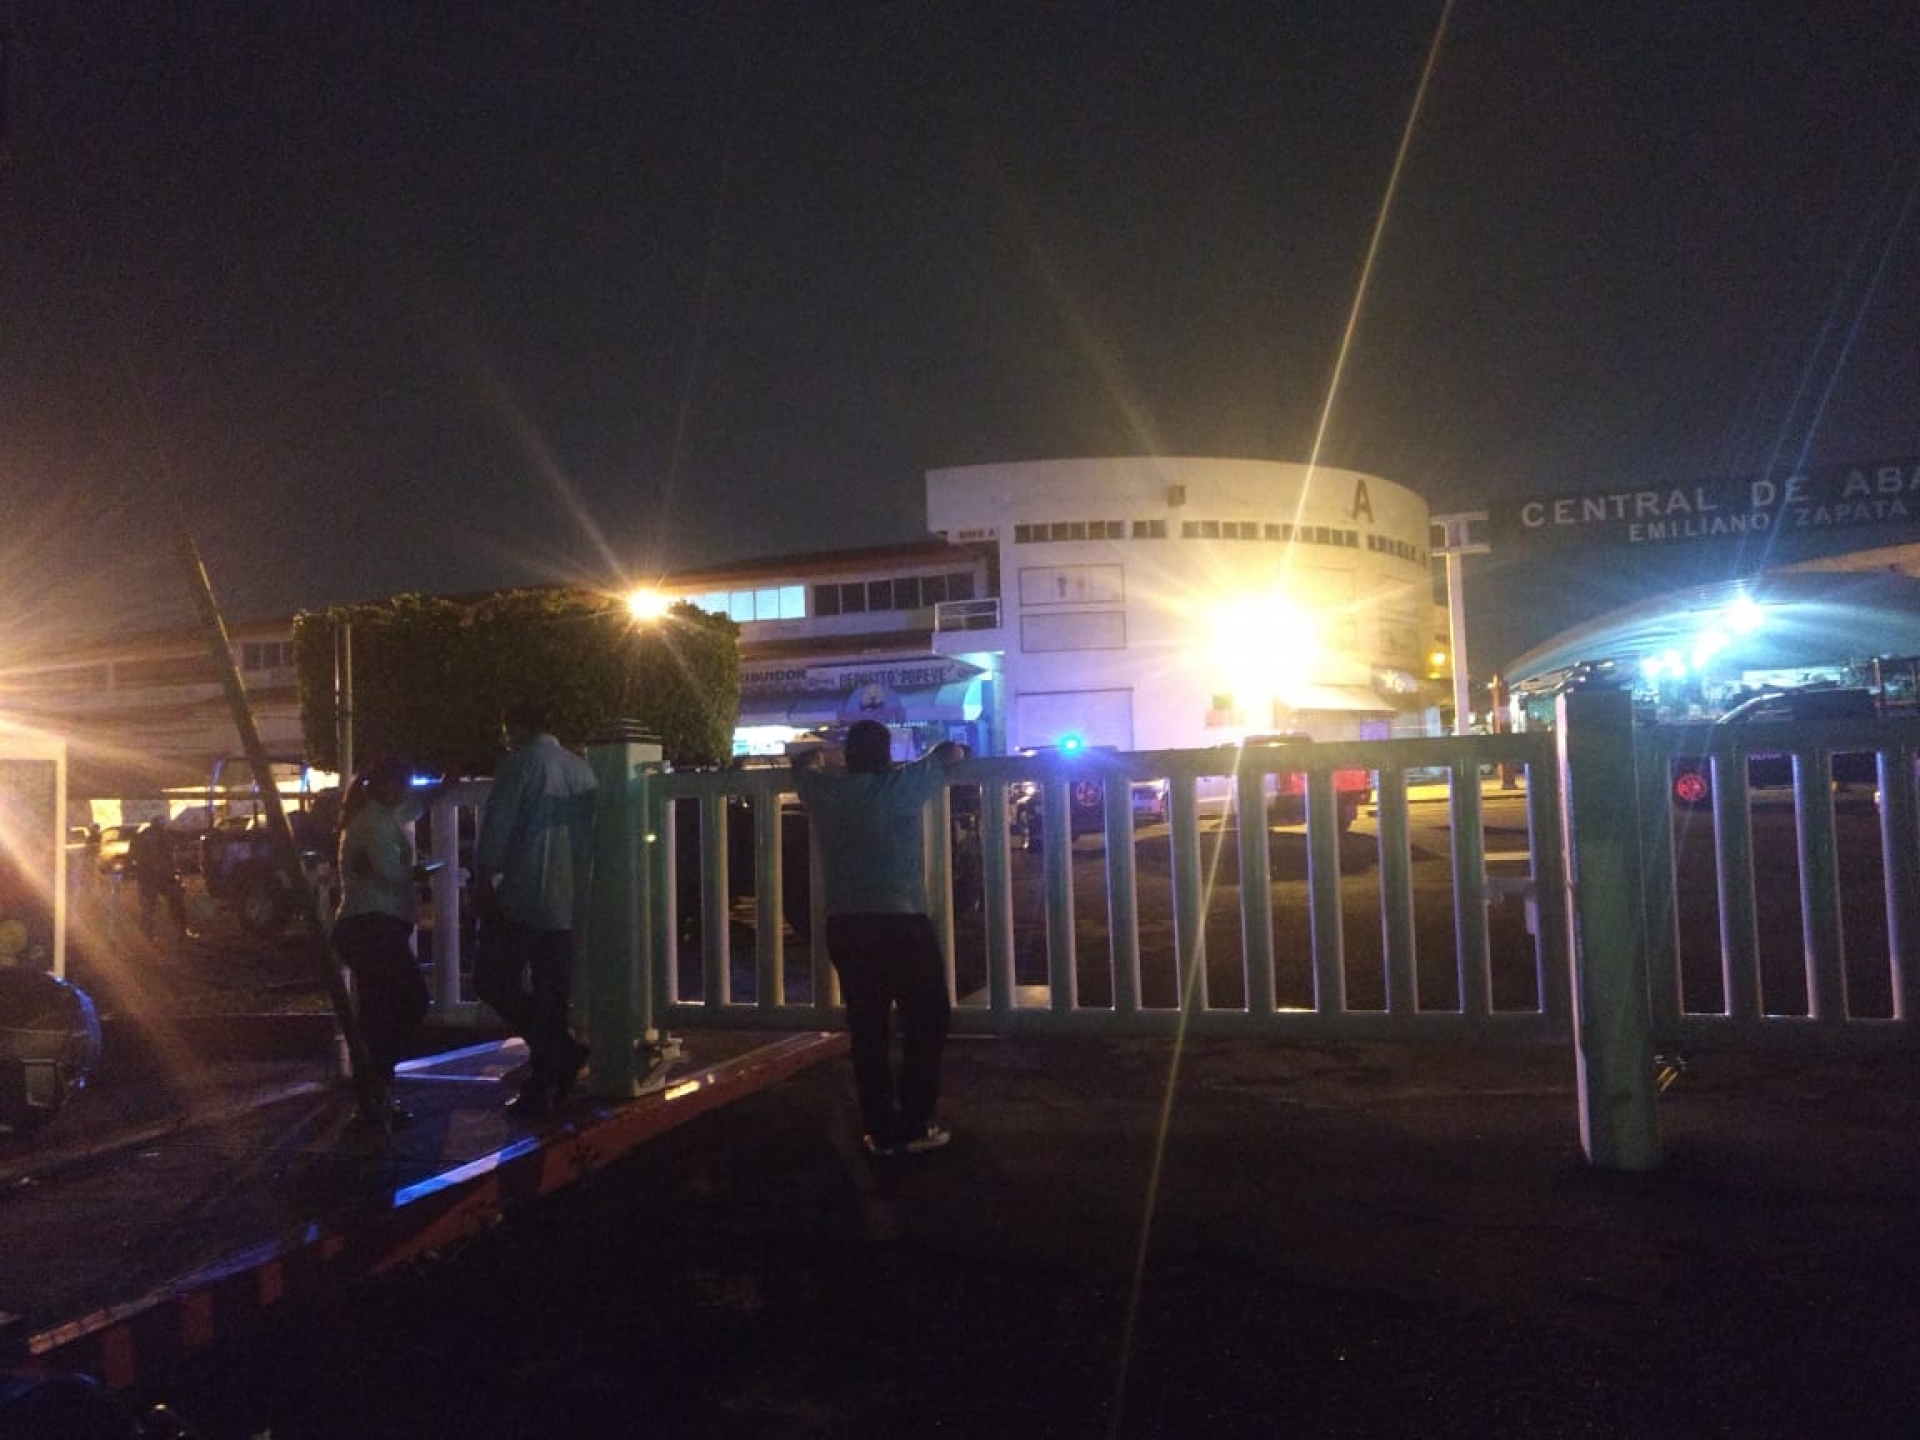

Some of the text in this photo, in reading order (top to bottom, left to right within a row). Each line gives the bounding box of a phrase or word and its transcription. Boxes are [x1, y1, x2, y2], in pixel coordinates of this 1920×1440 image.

[1352, 479, 1374, 523] A
[1520, 486, 1719, 528] CENTRAL
[1751, 476, 1810, 507] DE
[1629, 499, 1908, 542] EMILIANO ZAPATA
